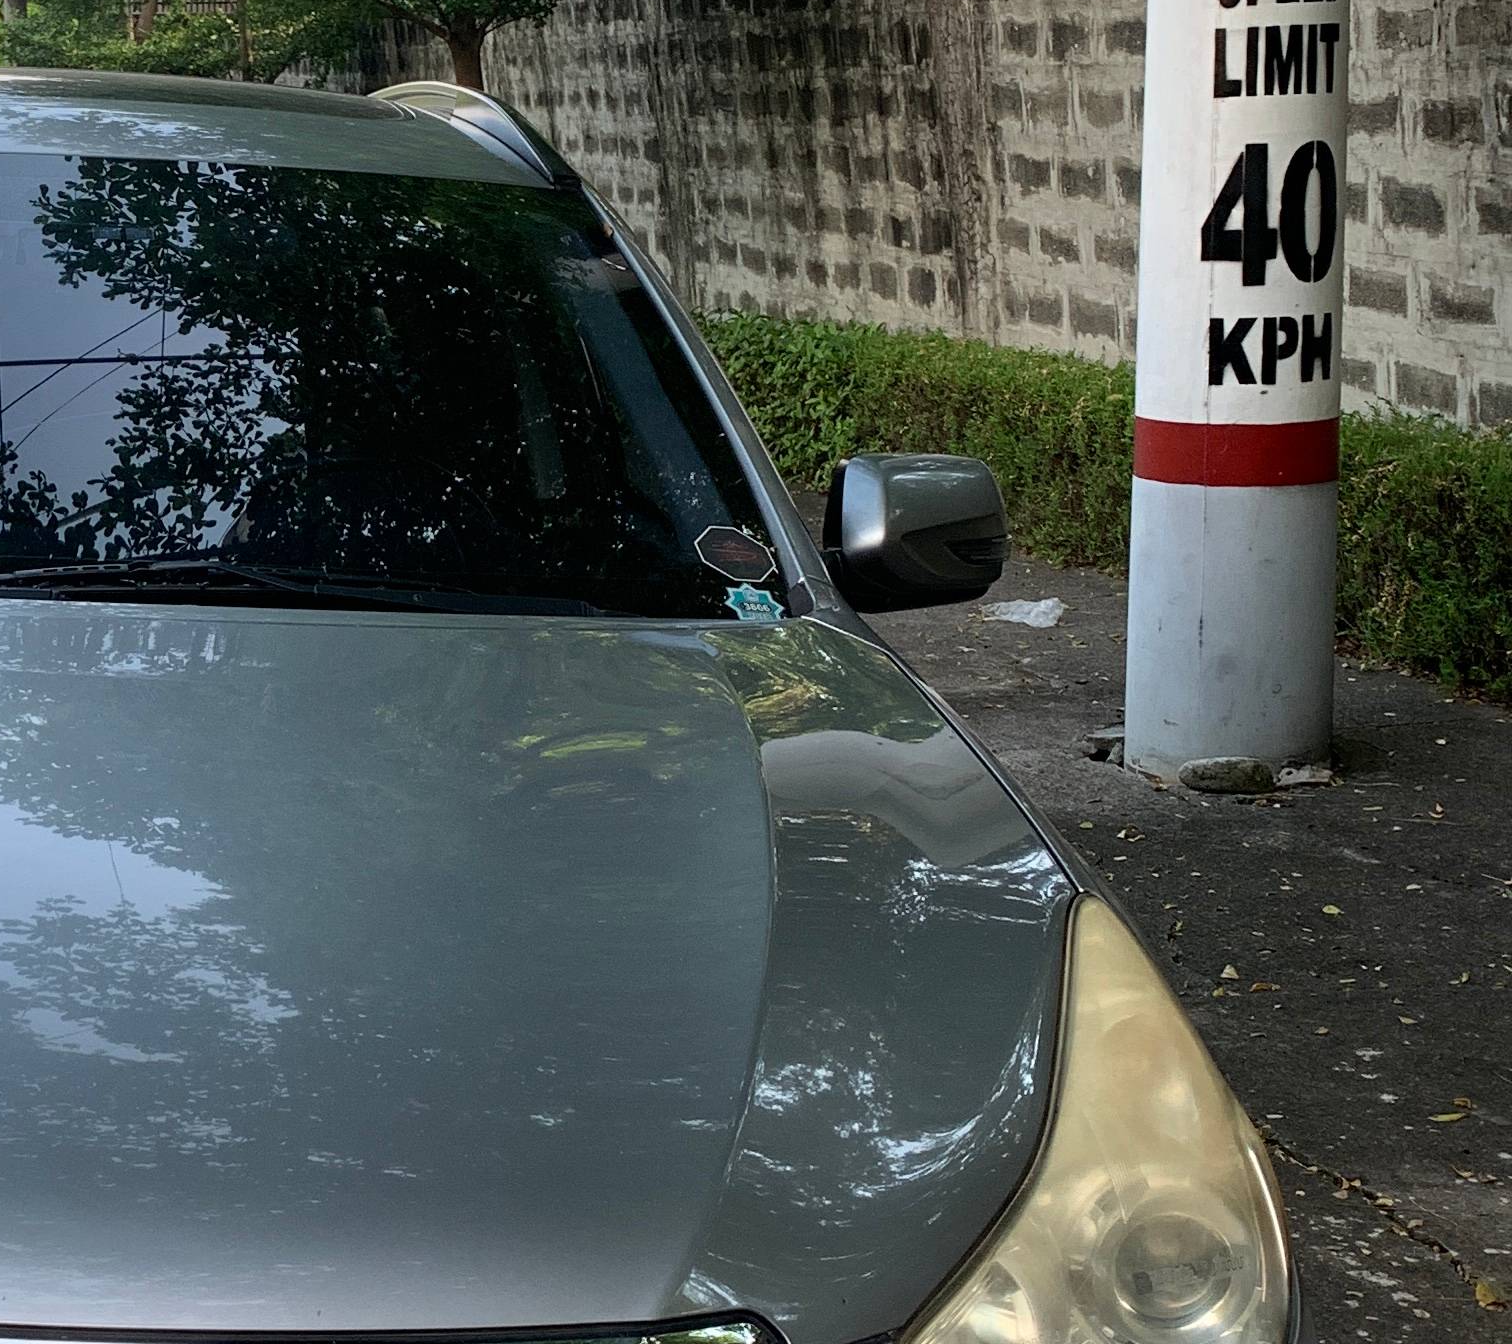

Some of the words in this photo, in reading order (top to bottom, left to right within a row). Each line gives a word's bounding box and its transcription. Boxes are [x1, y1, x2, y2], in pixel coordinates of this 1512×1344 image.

[1213, 23, 1340, 98] LIMIT
[1201, 140, 1337, 287] 40
[1207, 312, 1332, 386] KPH
